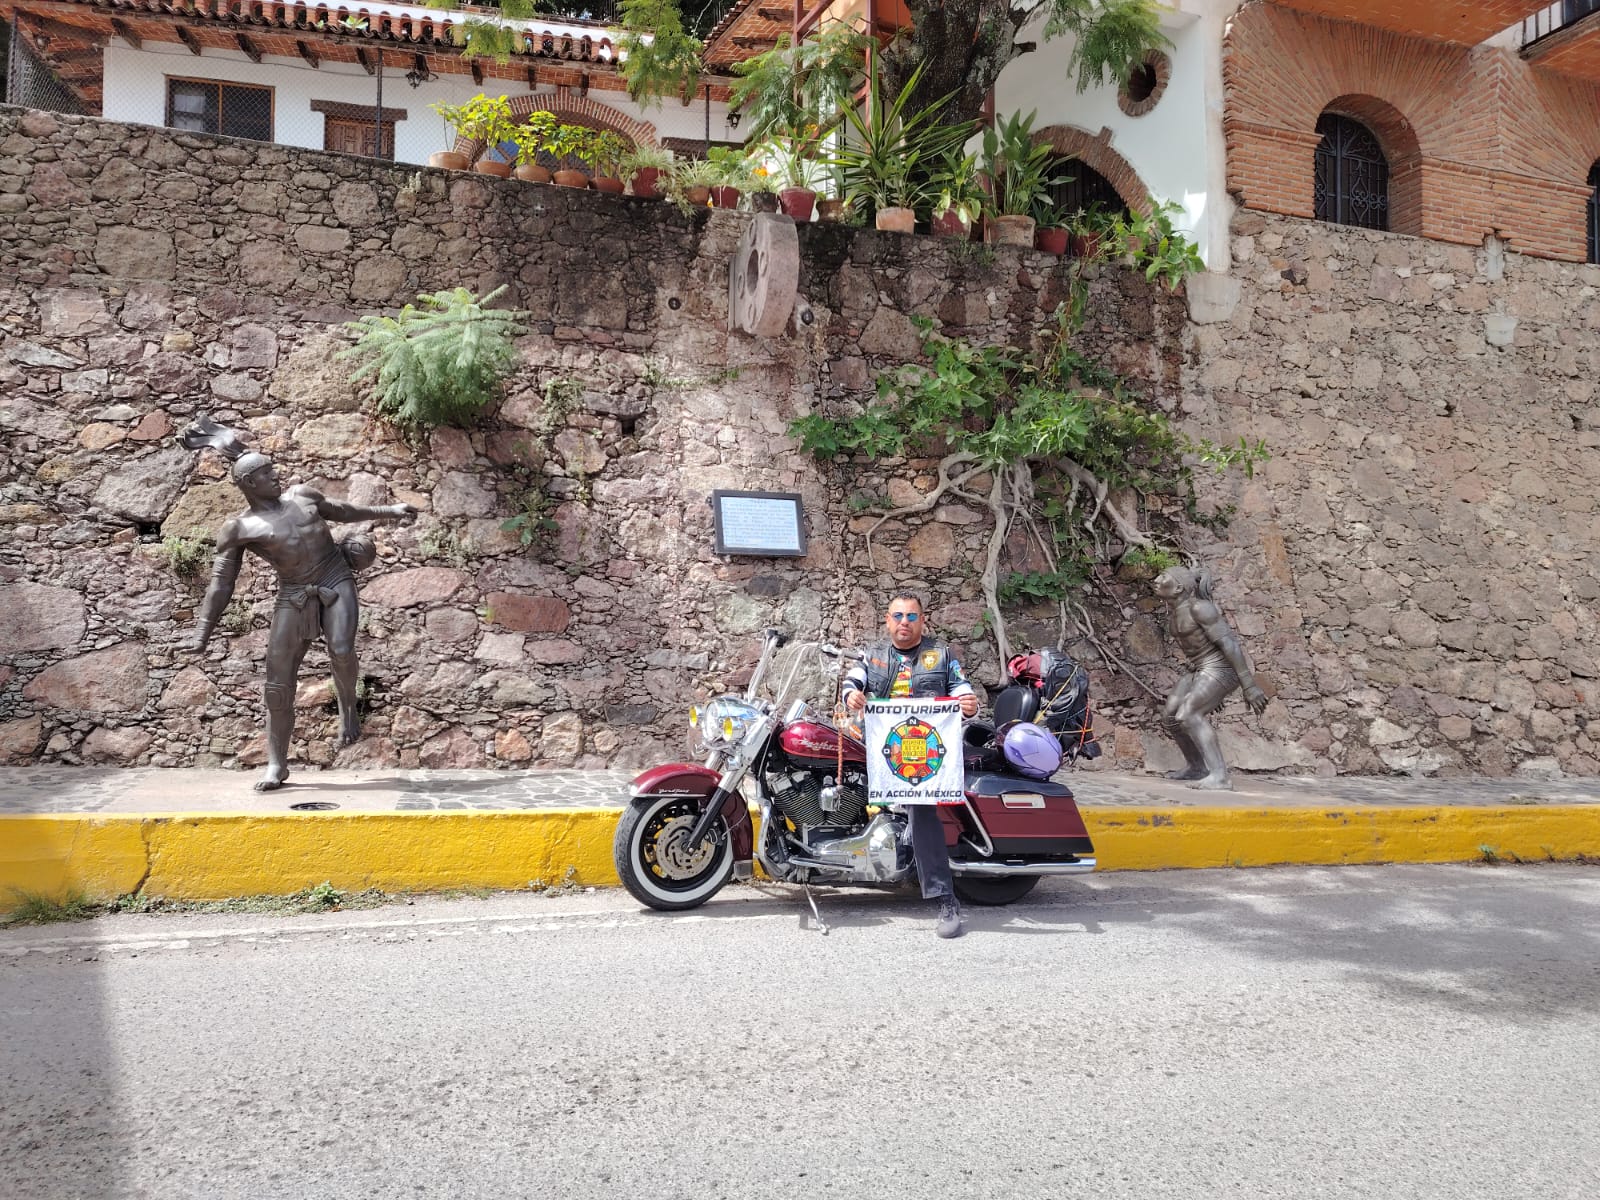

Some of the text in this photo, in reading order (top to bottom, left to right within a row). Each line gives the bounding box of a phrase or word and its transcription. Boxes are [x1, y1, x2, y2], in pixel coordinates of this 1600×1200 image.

[865, 704, 960, 714] MOTOTURISMO
[886, 788, 921, 797] ACCIÓN
[925, 788, 961, 797] MÉXICO
